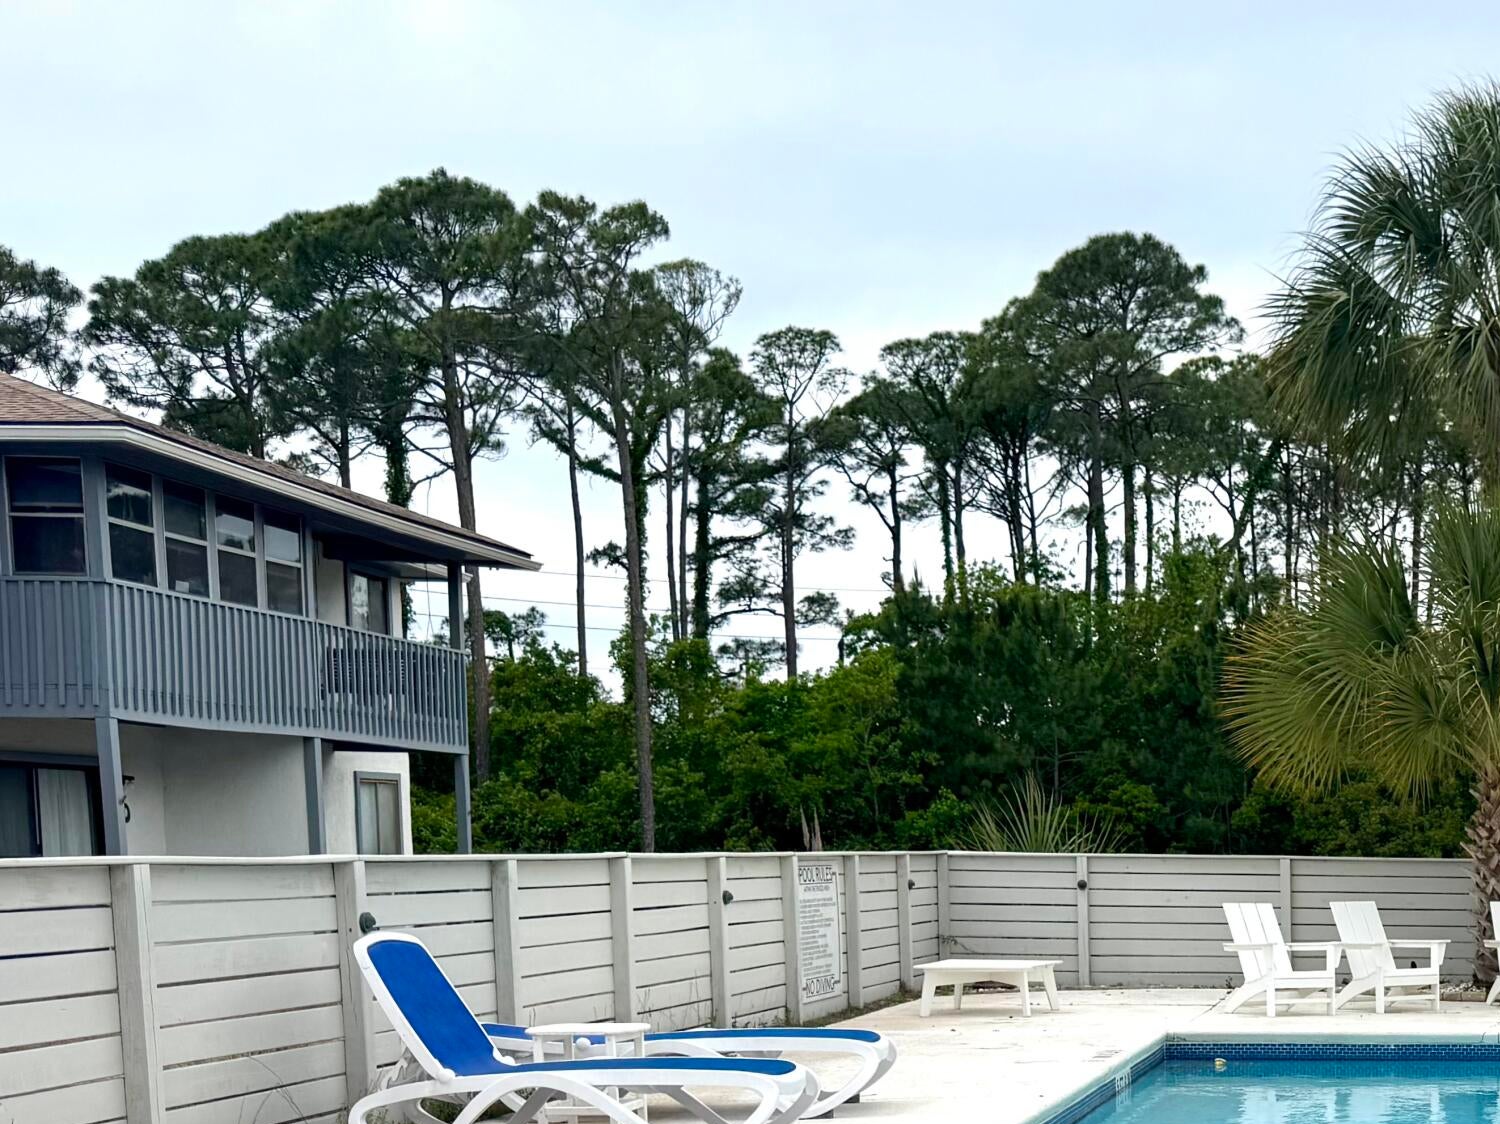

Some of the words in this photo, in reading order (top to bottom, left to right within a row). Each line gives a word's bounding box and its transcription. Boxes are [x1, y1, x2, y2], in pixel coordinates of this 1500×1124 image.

[799, 867, 815, 882] POOL
[816, 866, 832, 881] RULES
[806, 979, 815, 995] NO
[816, 976, 834, 993] DIVING
